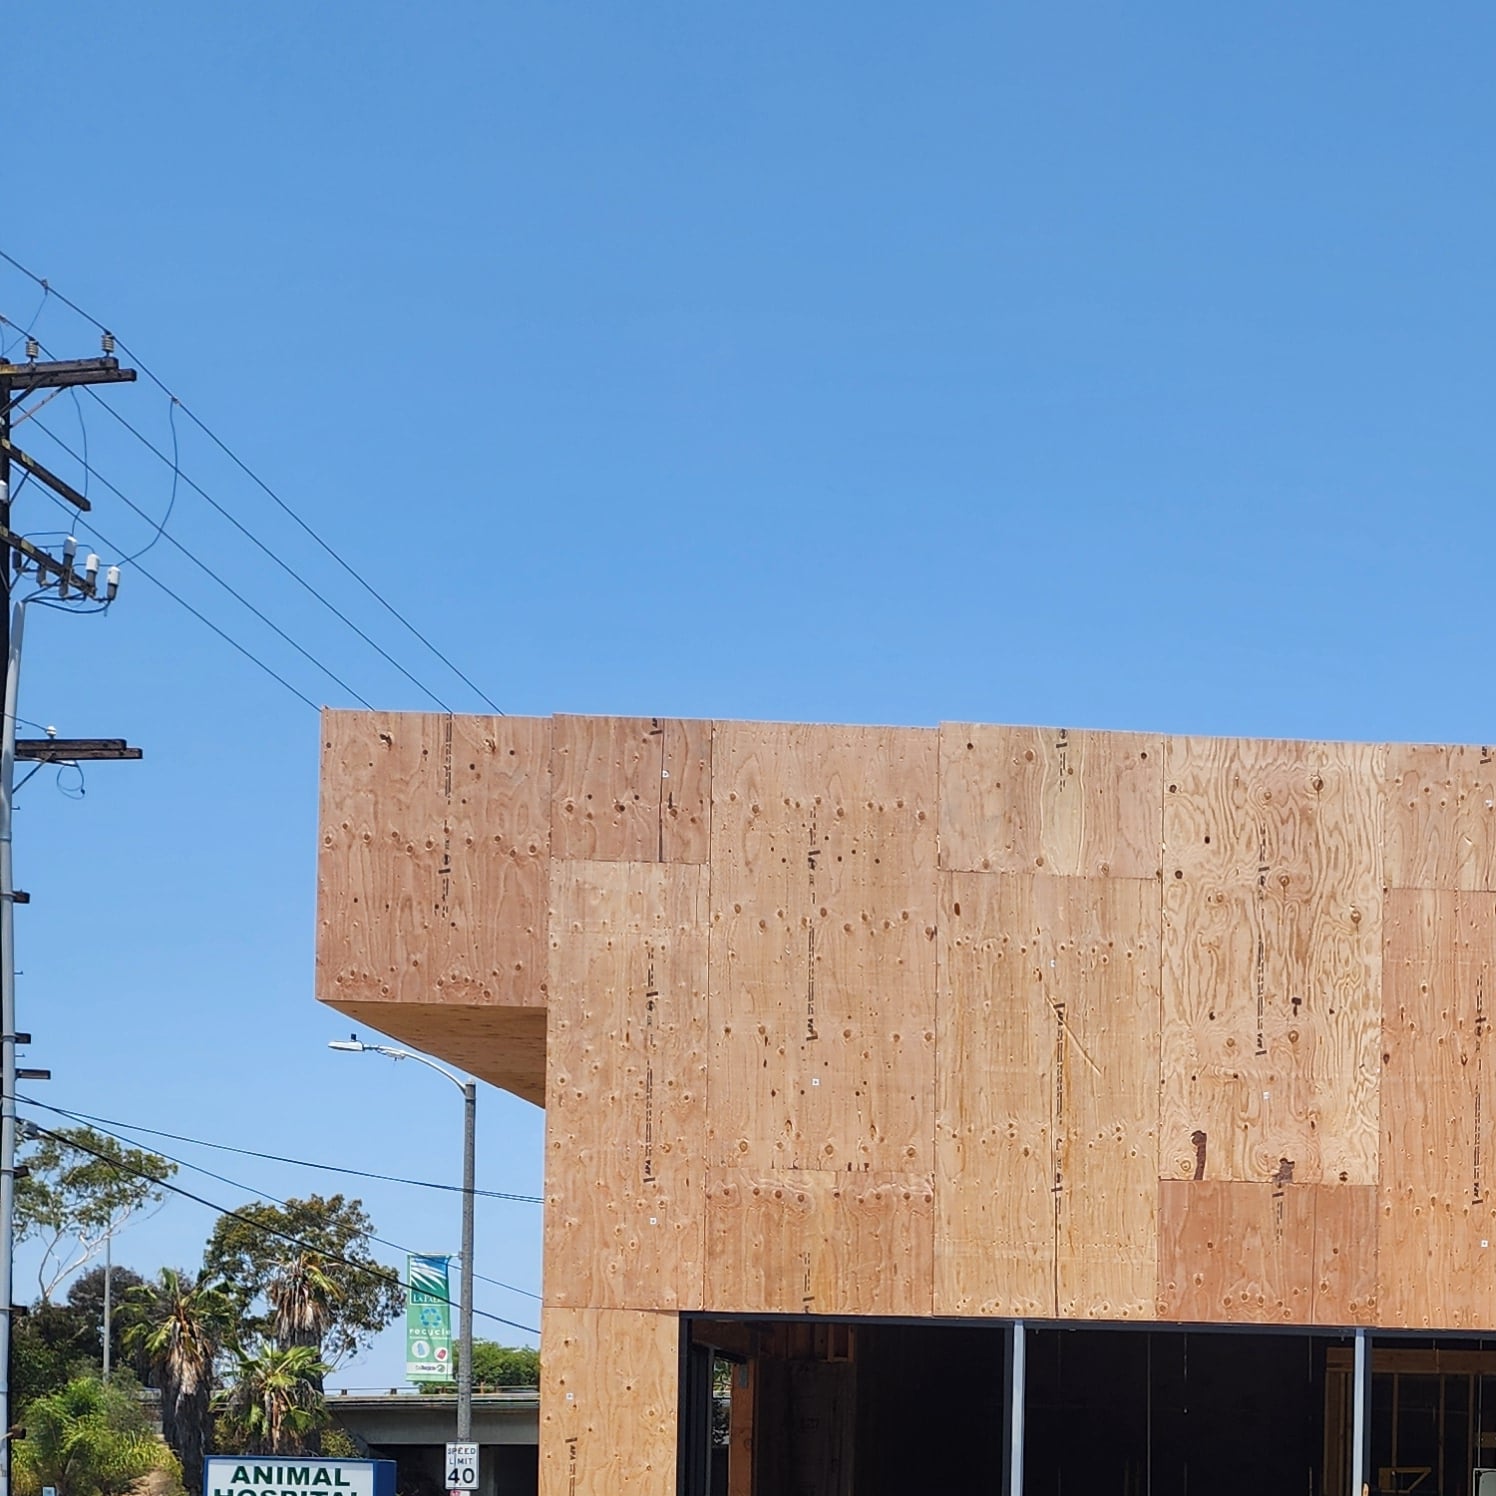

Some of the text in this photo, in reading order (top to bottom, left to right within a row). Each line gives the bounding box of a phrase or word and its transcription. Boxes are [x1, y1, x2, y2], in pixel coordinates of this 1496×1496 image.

[448, 1447, 476, 1455] SPEED
[449, 1457, 473, 1465] LIMIT
[230, 1465, 350, 1487] ANIMAL
[448, 1467, 475, 1484] 40
